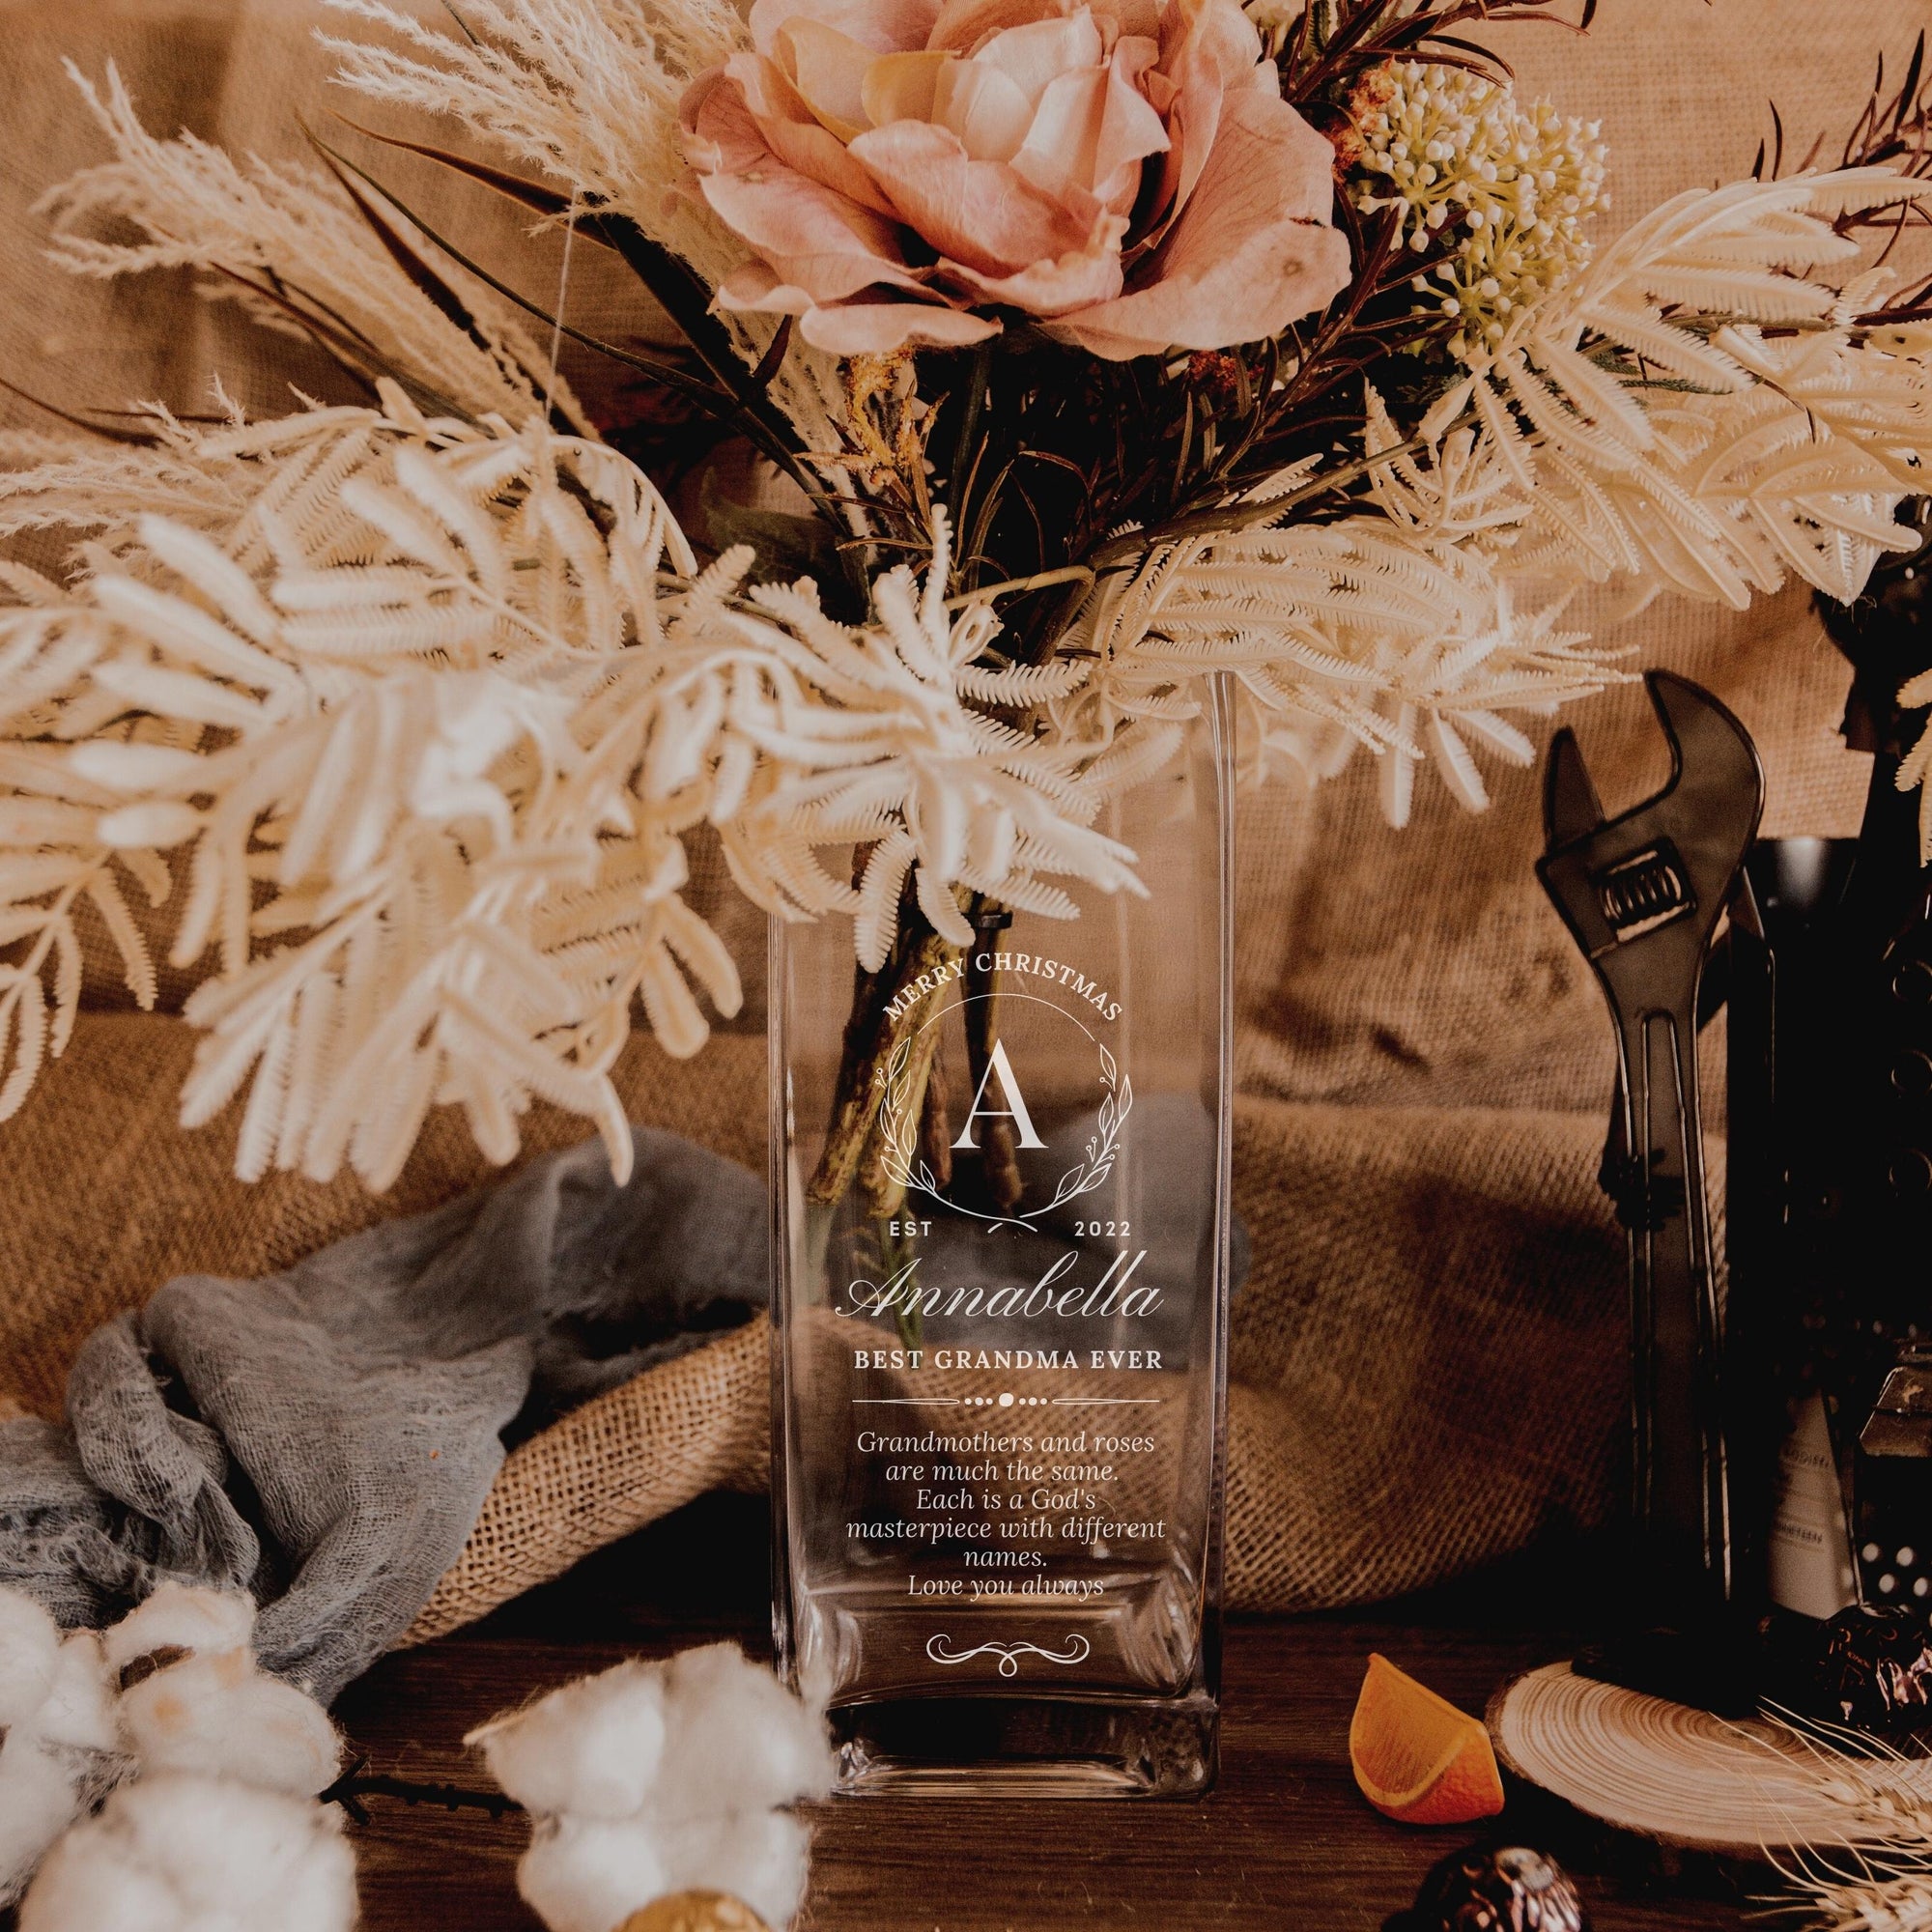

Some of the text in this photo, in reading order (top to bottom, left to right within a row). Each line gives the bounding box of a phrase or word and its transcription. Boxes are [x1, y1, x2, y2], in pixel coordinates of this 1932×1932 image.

[883, 952, 1122, 1021] MERRY CHRISTMAS
[949, 1037, 1049, 1149] A
[889, 1221, 1131, 1236] EST 2022
[835, 1249, 1165, 1318] Annabella
[854, 1350, 1163, 1369] BEST GRANDMA EVER
[857, 1431, 1155, 1453] Grandmothers and roses
[885, 1460, 1119, 1482] are much the same.
[916, 1488, 1096, 1510] Each is a God's
[845, 1517, 1167, 1545] masterpiece with different
[963, 1550, 1048, 1567] names.
[908, 1575, 1104, 1602] Love you always
